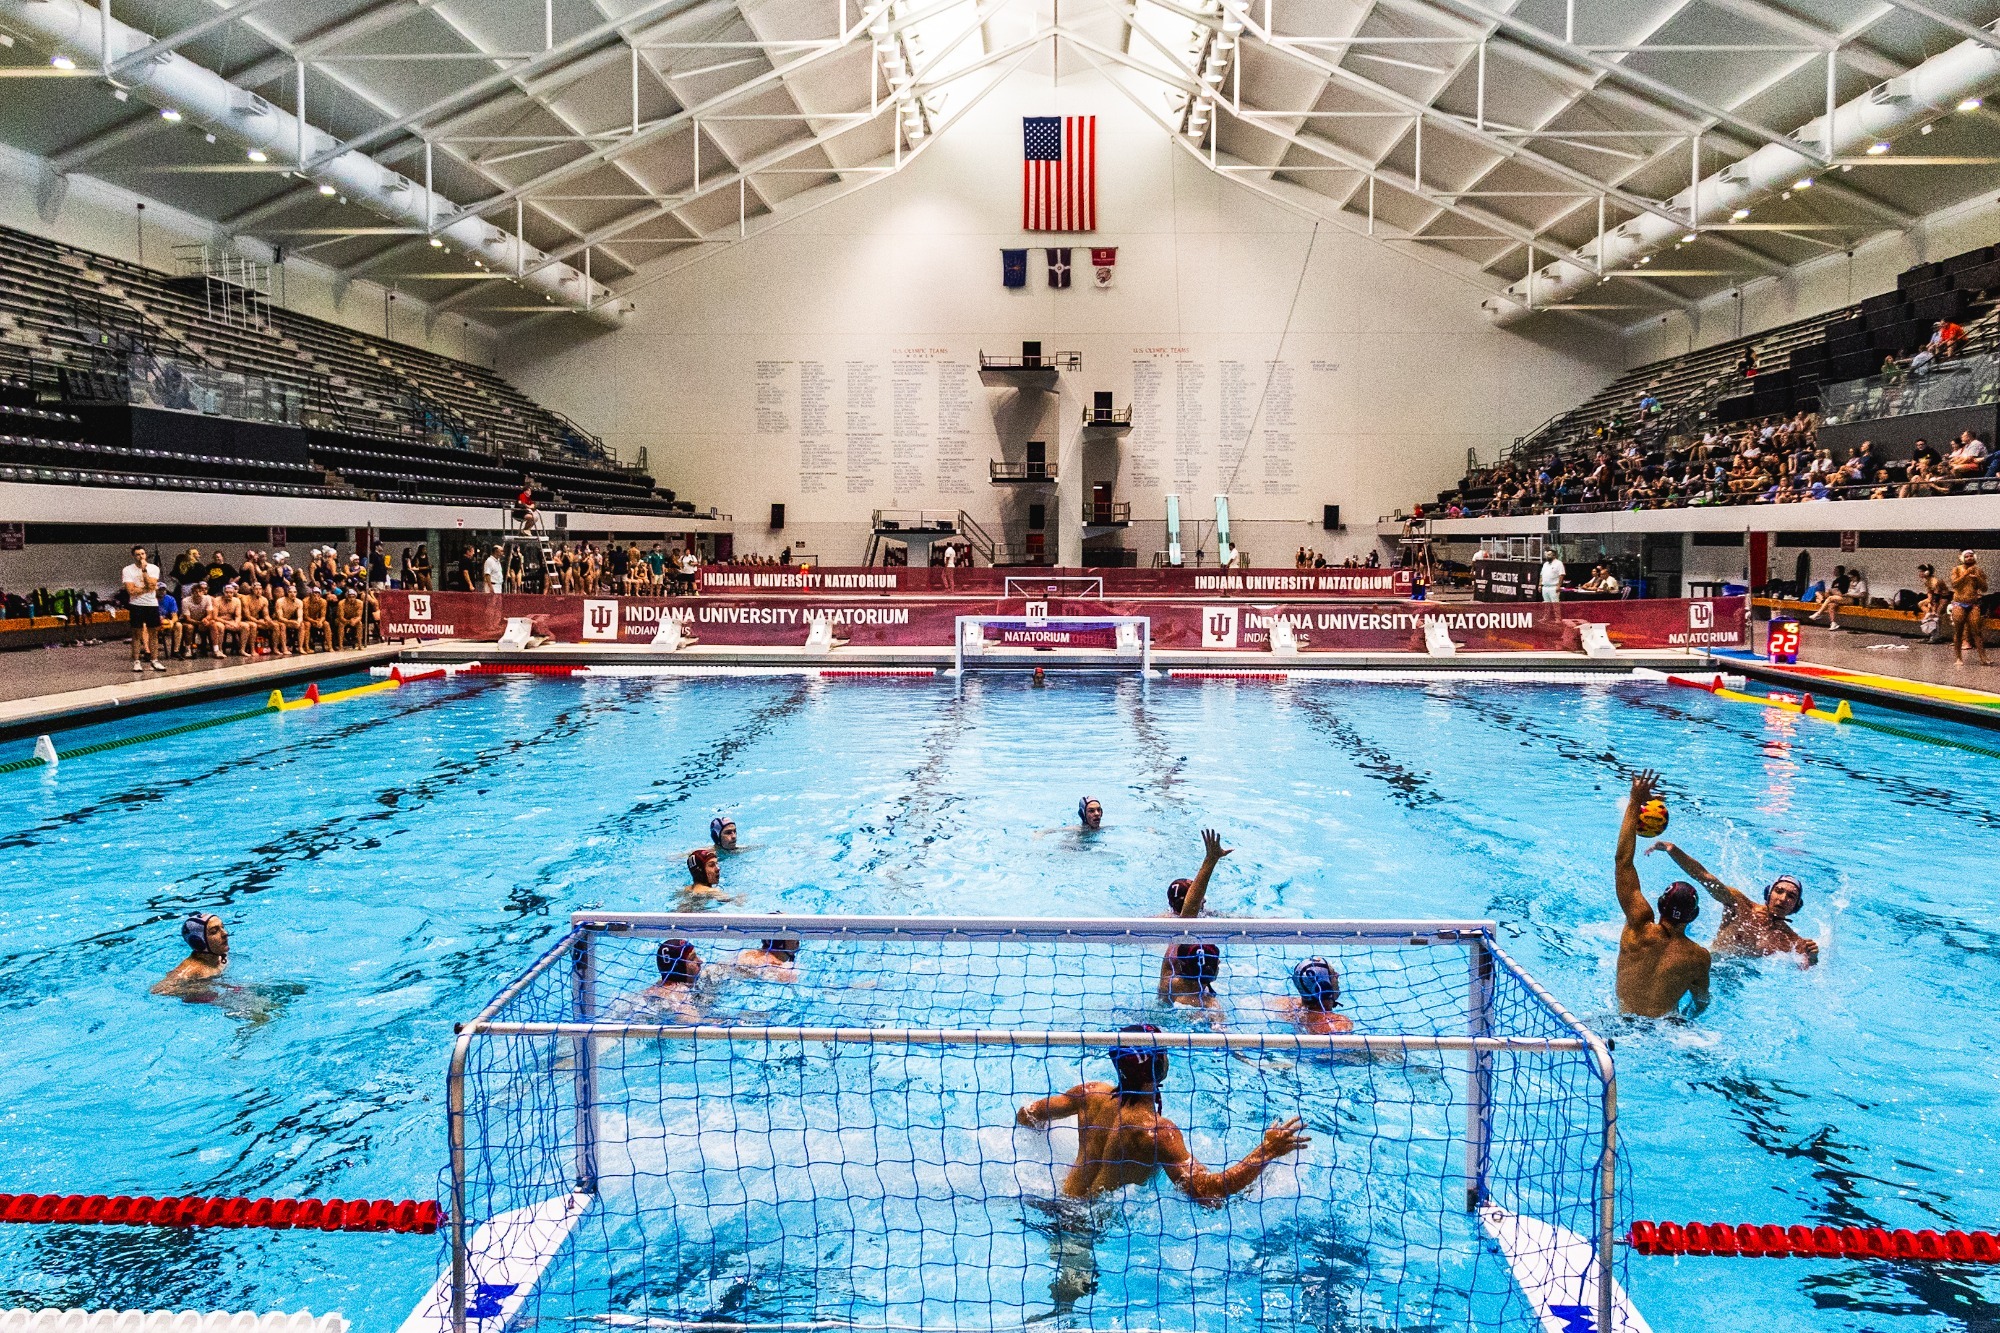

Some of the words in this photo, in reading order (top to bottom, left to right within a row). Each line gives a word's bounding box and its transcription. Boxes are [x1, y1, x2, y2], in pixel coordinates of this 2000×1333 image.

[703, 573, 750, 587] INDIANA
[753, 573, 821, 588] UNIVERSITY
[824, 574, 897, 588] NATATORIUM
[1195, 576, 1242, 589] INDIANA
[1246, 576, 1315, 590] UNIVERSITY
[1318, 576, 1393, 590] NATATORIUM
[625, 605, 696, 623] INDIANA
[699, 607, 799, 624] UNIVERSITY
[802, 608, 909, 625] NATATORIUM
[1244, 612, 1314, 630] INDIANA
[1317, 613, 1420, 630] UNIVERSITY
[1424, 612, 1533, 630] NATATORIUM
[388, 622, 454, 635] NATATORIUM
[1004, 631, 1070, 643] NATATORIUM
[1668, 631, 1739, 644] NATATORIUM
[1770, 633, 1798, 653] 22
[1171, 883, 1180, 898] 7
[661, 947, 671, 964] 6
